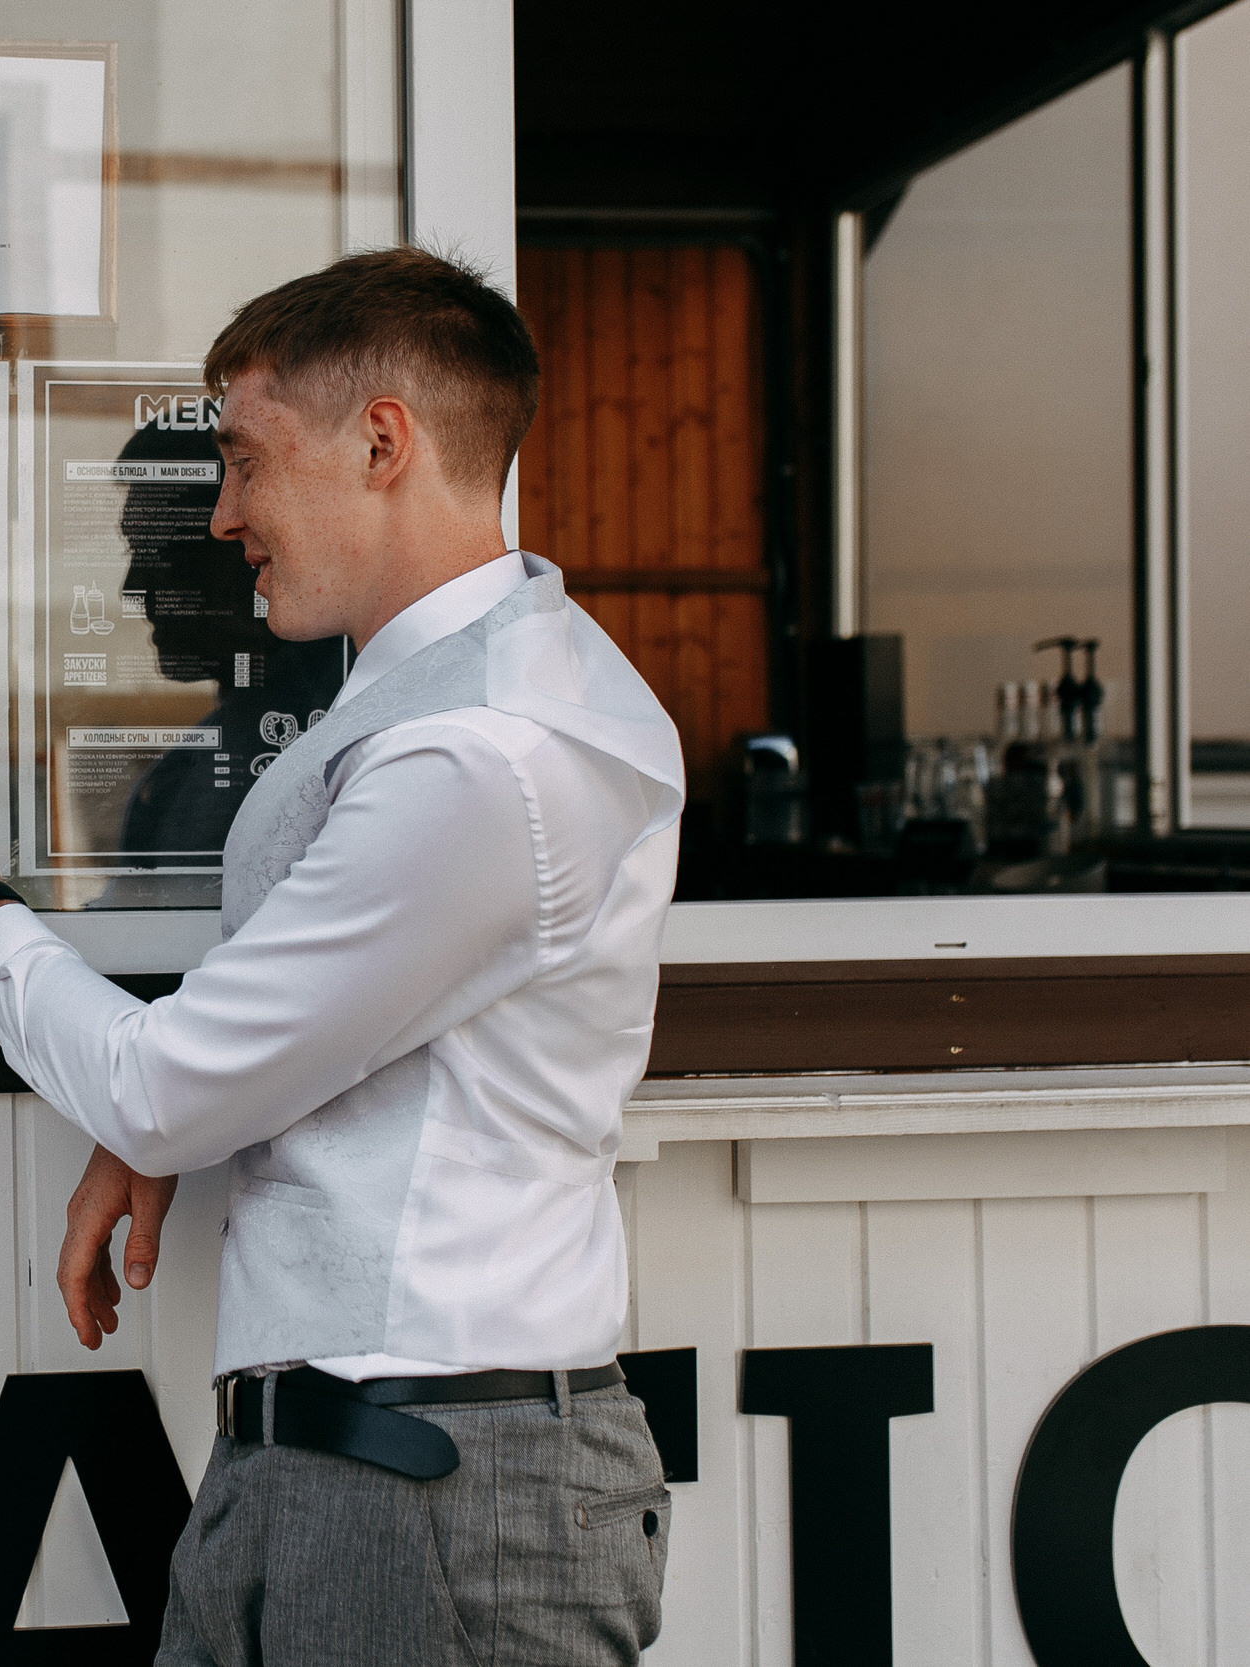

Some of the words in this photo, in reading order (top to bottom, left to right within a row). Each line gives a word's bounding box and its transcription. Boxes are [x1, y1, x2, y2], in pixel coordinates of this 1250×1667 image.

[134, 394, 225, 431] MEN
[76, 466, 117, 476] ОСНОВНЫЕ
[118, 466, 147, 477] БЛЮДА
[160, 467, 179, 477] MAIN
[180, 467, 206, 477] DISHES
[63, 658, 107, 670] ЗАКУСКИ
[63, 671, 107, 681] APPETIZERS
[82, 733, 126, 743] ХОЛОДНЫЕ
[127, 733, 150, 744] СУПЫ
[162, 733, 180, 743] COLD
[181, 733, 205, 743] SOUPS
